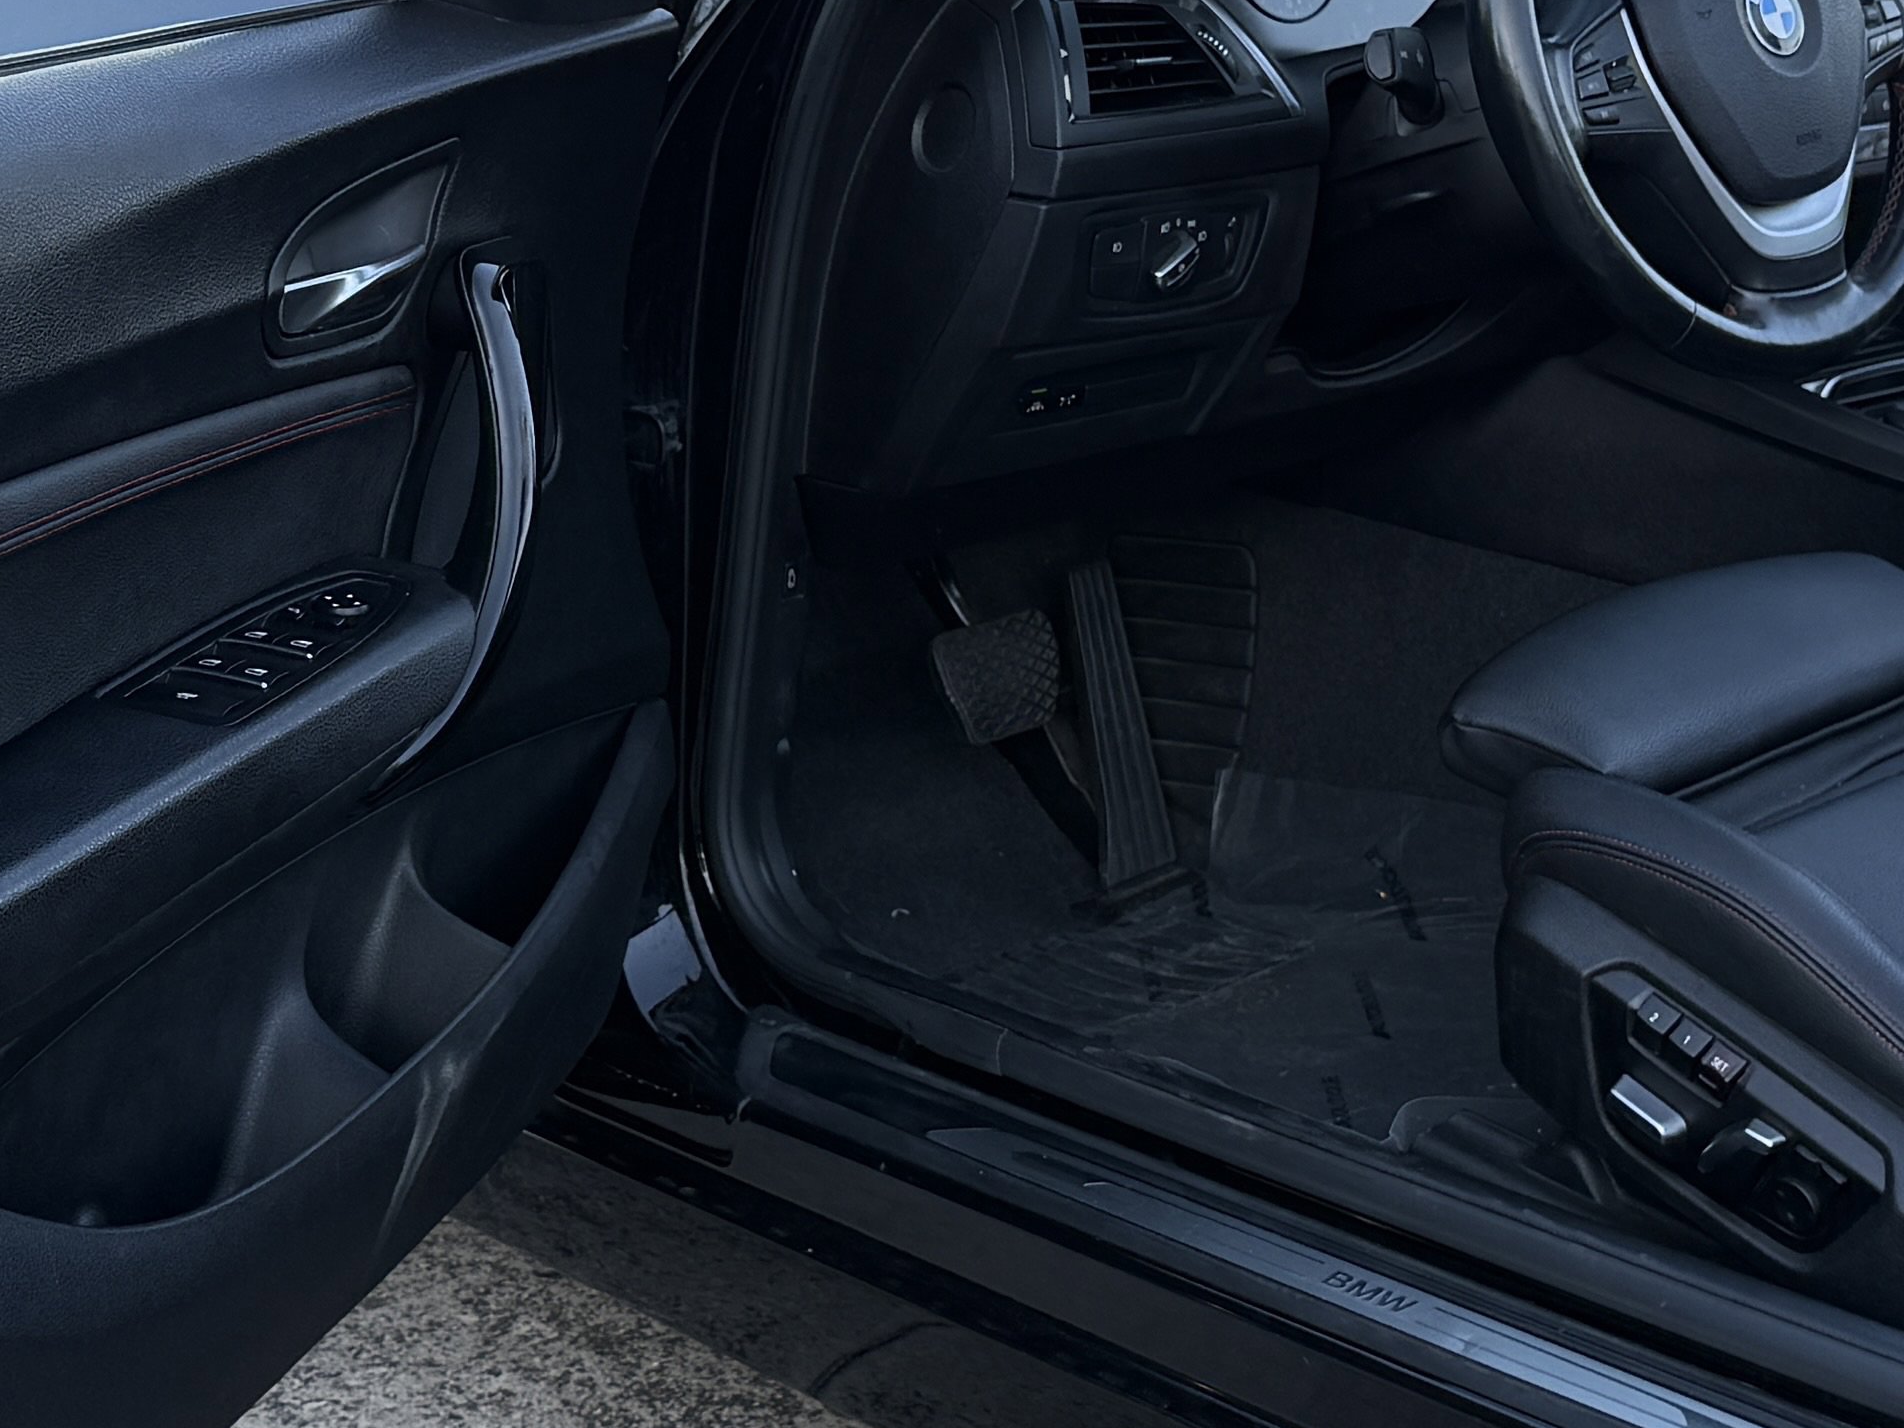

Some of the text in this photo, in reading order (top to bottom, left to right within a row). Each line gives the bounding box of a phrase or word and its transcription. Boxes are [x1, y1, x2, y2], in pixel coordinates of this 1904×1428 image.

[1648, 1012, 1659, 1023] 2
[1683, 1035, 1691, 1045] 1
[1321, 1271, 1419, 1312] BMW
